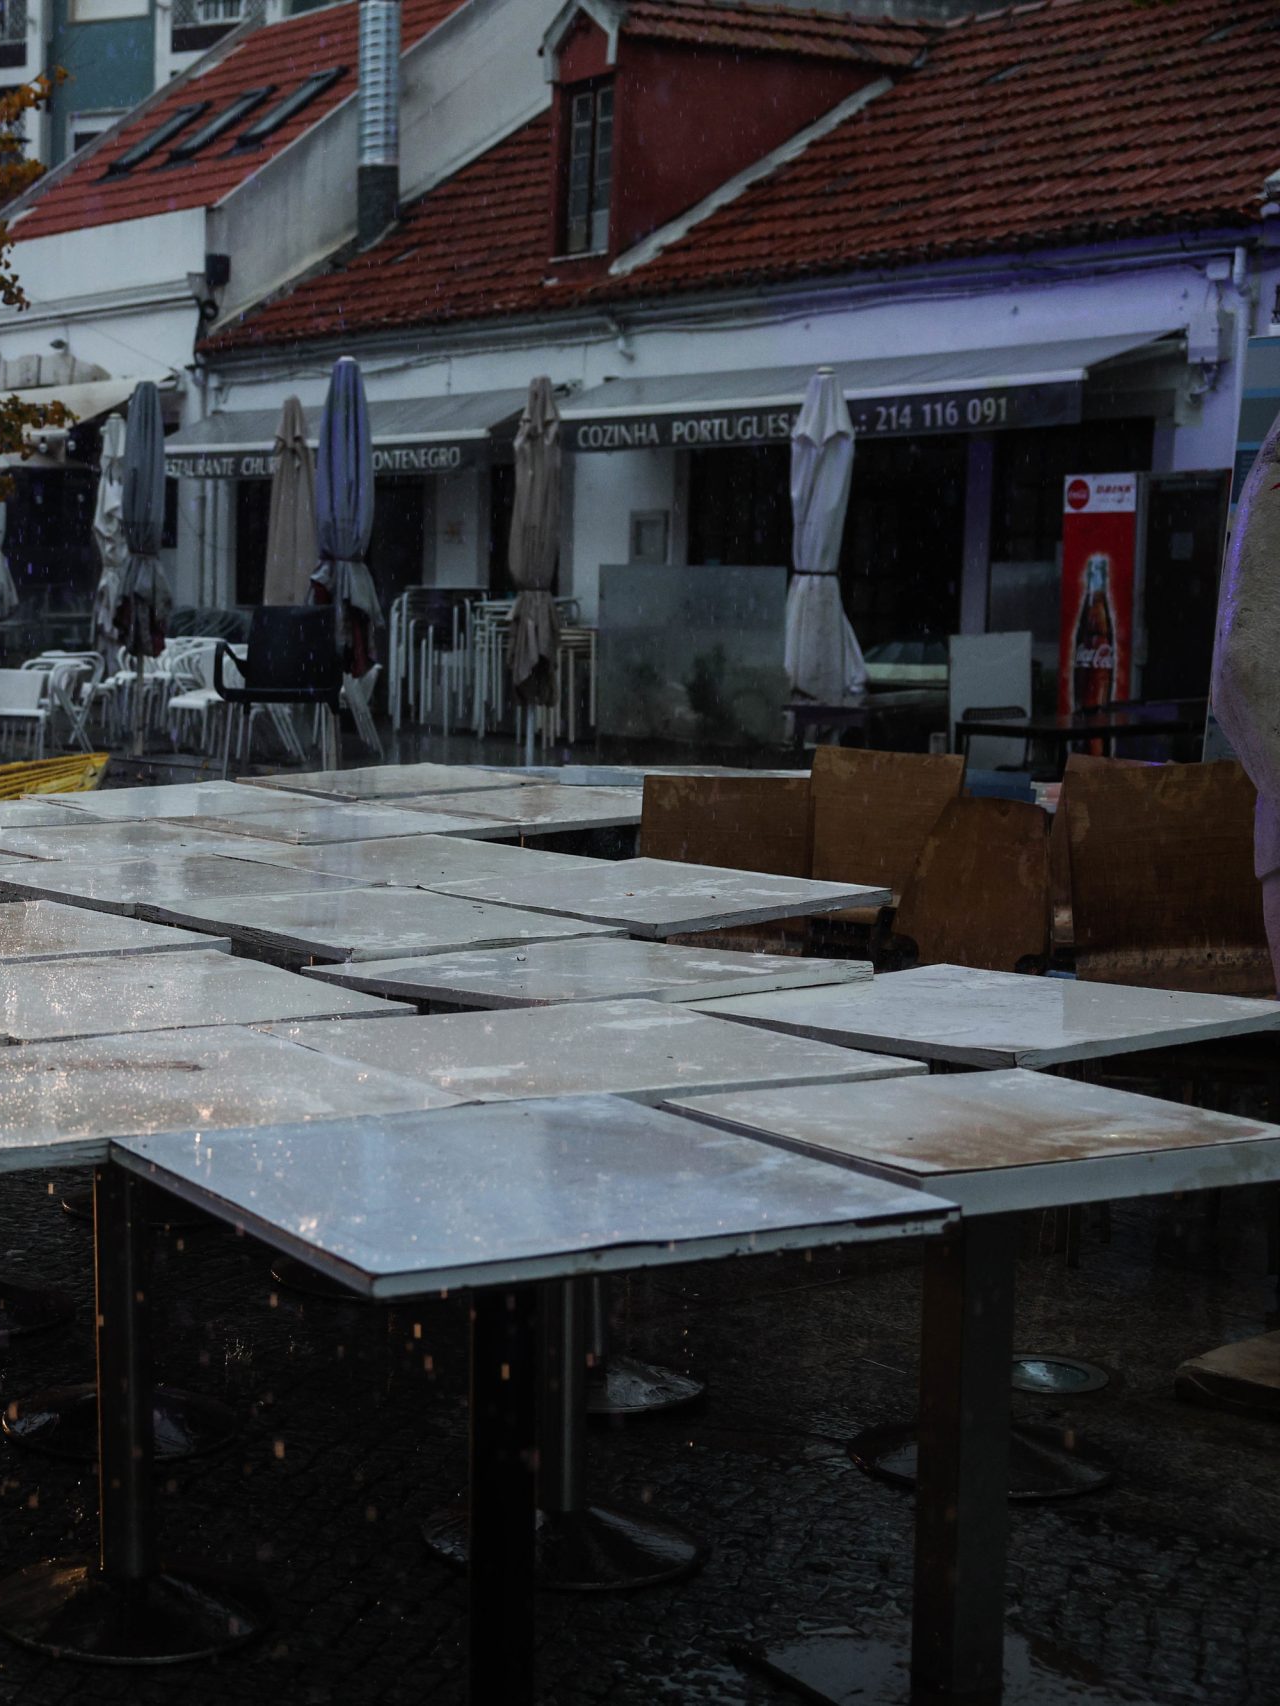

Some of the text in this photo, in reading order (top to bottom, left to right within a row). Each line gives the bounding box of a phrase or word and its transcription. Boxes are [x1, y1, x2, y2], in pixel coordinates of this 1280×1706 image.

[577, 422, 660, 448] COZINHA
[672, 413, 799, 443] PORTUGUES
[875, 404, 912, 431] 214
[922, 400, 958, 427] 116
[966, 397, 1008, 425] 091
[165, 456, 235, 476] ESTAURANTE
[373, 446, 461, 471] ONTENEGRO
